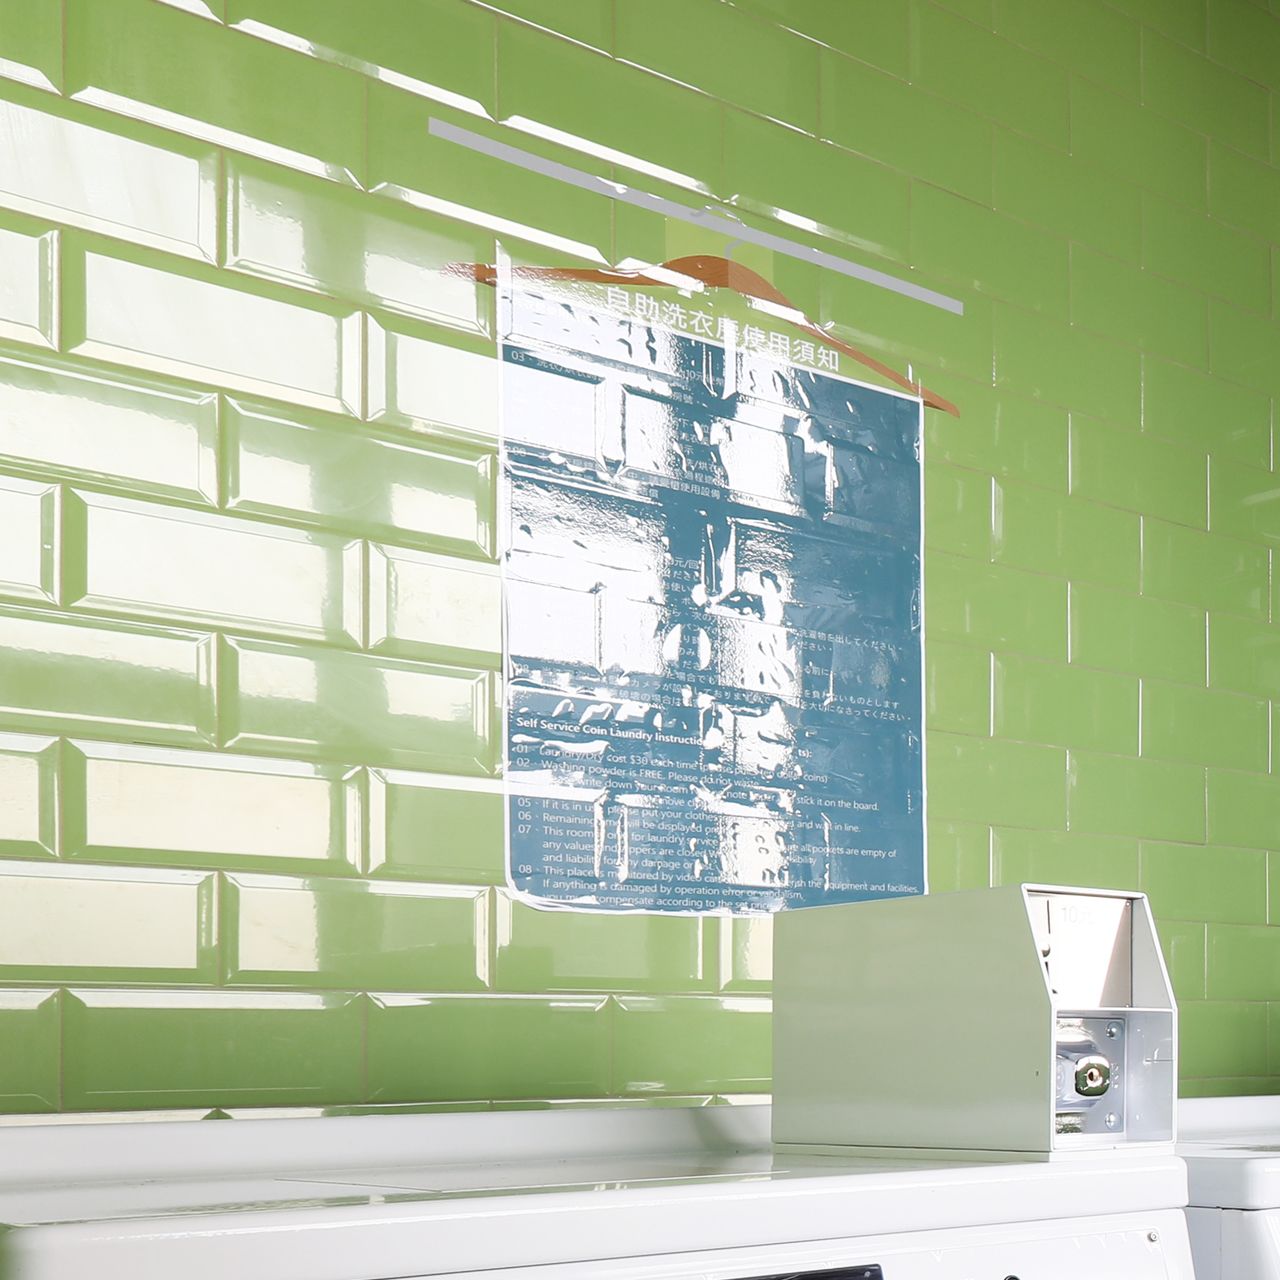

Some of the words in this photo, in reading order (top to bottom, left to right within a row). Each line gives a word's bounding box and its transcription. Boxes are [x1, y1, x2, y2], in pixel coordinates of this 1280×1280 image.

[516, 717, 537, 728] Self
[540, 719, 580, 733] Service
[582, 724, 608, 736] Coin
[610, 727, 653, 742] Laundry
[655, 732, 703, 746] Instructio
[606, 754, 628, 764] cost
[588, 765, 625, 776] powder
[668, 771, 698, 783] Please
[605, 780, 633, 789] down
[726, 791, 748, 800] note
[797, 796, 815, 805] stick
[838, 800, 852, 808] the
[641, 808, 659, 818] put
[660, 810, 683, 819] your
[642, 820, 656, 829] be
[658, 822, 703, 834] displayed
[542, 826, 564, 836] This
[566, 829, 594, 838] room
[631, 832, 645, 840] for
[647, 833, 684, 847] laundry
[687, 837, 719, 847] srvice
[845, 847, 859, 856] are
[861, 848, 887, 859] empty
[888, 849, 897, 858] of
[542, 841, 561, 851] any
[659, 848, 674, 856] are
[542, 853, 563, 863] and
[565, 854, 595, 865] liabilit
[543, 865, 564, 876] This
[567, 867, 594, 878] place
[607, 870, 659, 881] mitored
[661, 872, 674, 883] by
[808, 879, 822, 888] the
[827, 880, 868, 892] quipment
[869, 882, 886, 892] and
[552, 880, 598, 892] anything
[610, 882, 657, 894] damaged
[660, 884, 672, 895] by
[674, 885, 720, 896] operation
[596, 895, 654, 906] ompensate
[656, 897, 703, 909] according
[705, 899, 716, 908] to
